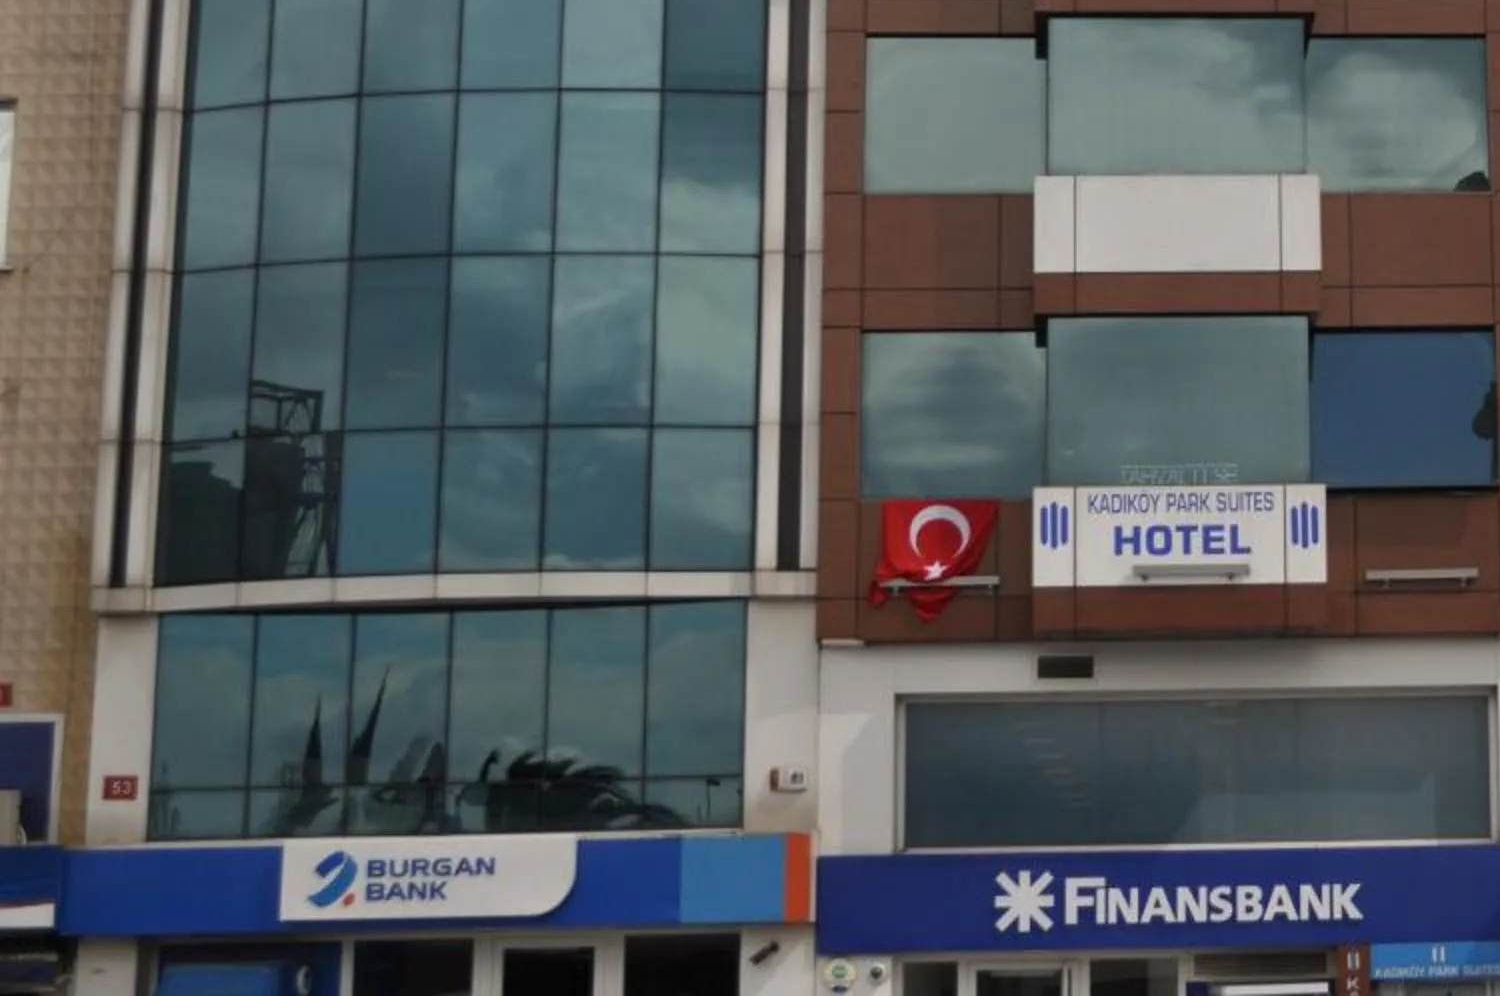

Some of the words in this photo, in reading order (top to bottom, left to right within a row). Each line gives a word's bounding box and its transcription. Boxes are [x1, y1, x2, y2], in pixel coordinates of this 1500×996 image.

[1166, 490, 1211, 512] PARK
[1216, 491, 1275, 512] SUITES
[1113, 524, 1252, 556] HOTEL
[367, 856, 496, 879] BURGAN
[365, 881, 447, 902] BANK
